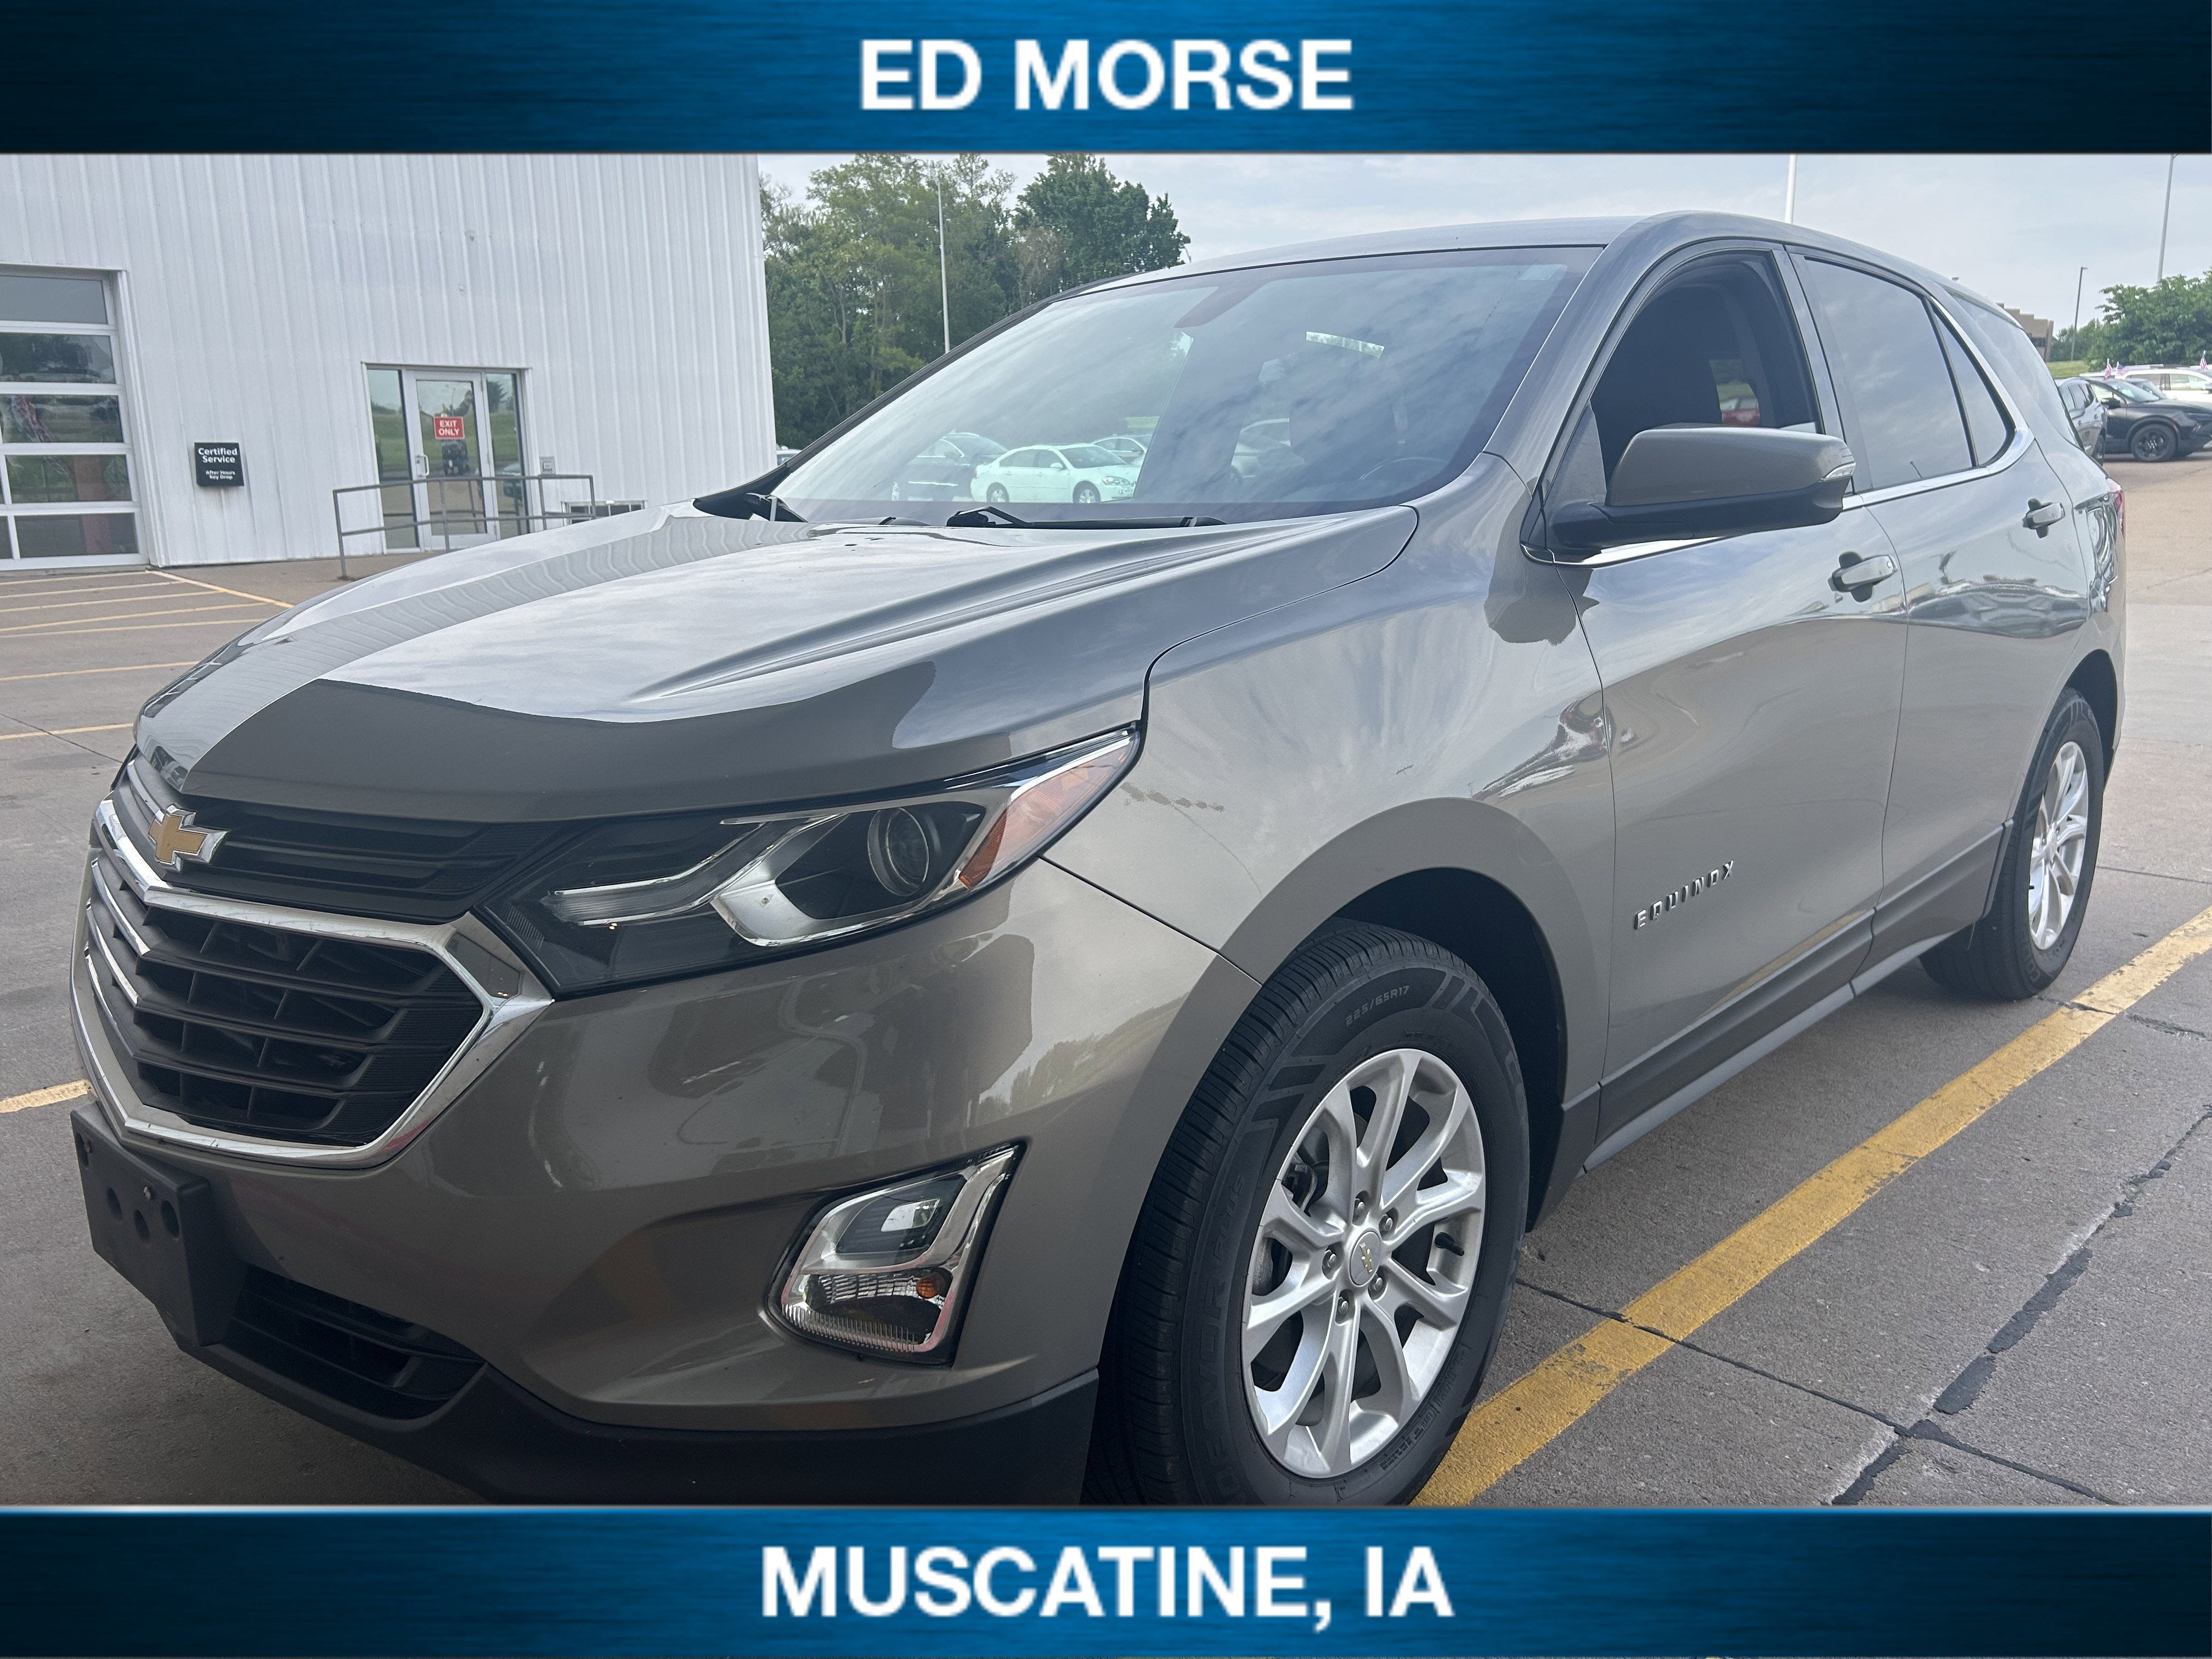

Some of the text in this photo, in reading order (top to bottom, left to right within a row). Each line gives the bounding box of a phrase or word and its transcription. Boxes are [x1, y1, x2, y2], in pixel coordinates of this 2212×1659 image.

[439, 420, 457, 428] EXIT
[438, 428, 460, 436] ONLY
[198, 447, 238, 455] Certified
[202, 455, 235, 463] Service
[1634, 860, 1734, 930] EQUINOX
[1345, 985, 1409, 1027] 225/65R17
